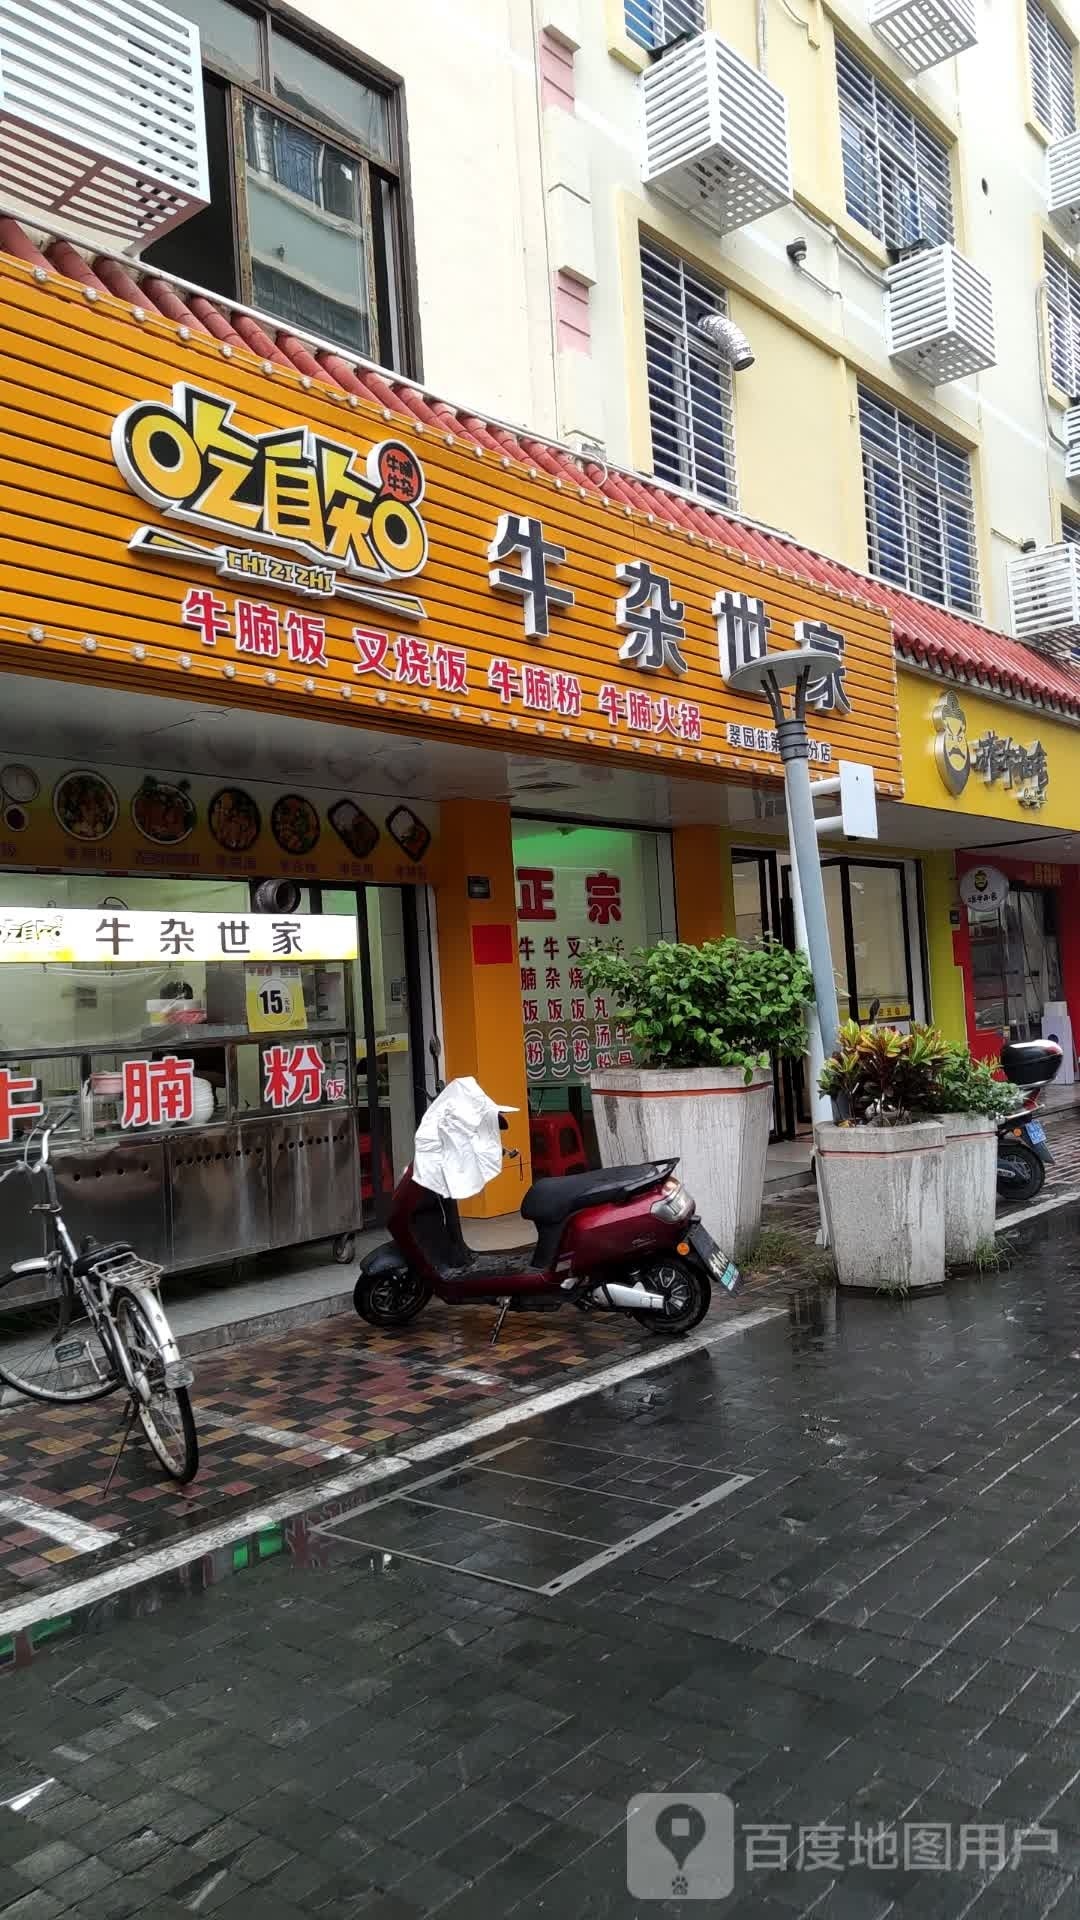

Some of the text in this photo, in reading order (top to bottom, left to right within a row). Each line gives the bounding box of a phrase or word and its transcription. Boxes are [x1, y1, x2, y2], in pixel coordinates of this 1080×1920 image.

[113, 382, 428, 580] 吃自知
[227, 550, 333, 593] CHI ZI ZHI
[488, 515, 852, 714] 牛杂世家
[183, 589, 701, 741] 牛腩饭 叉烧饭 牛腩粉 牛腩火锅
[516, 866, 622, 924] 正宗
[96, 917, 303, 955] 牛杂世家
[259, 989, 283, 1015] 15
